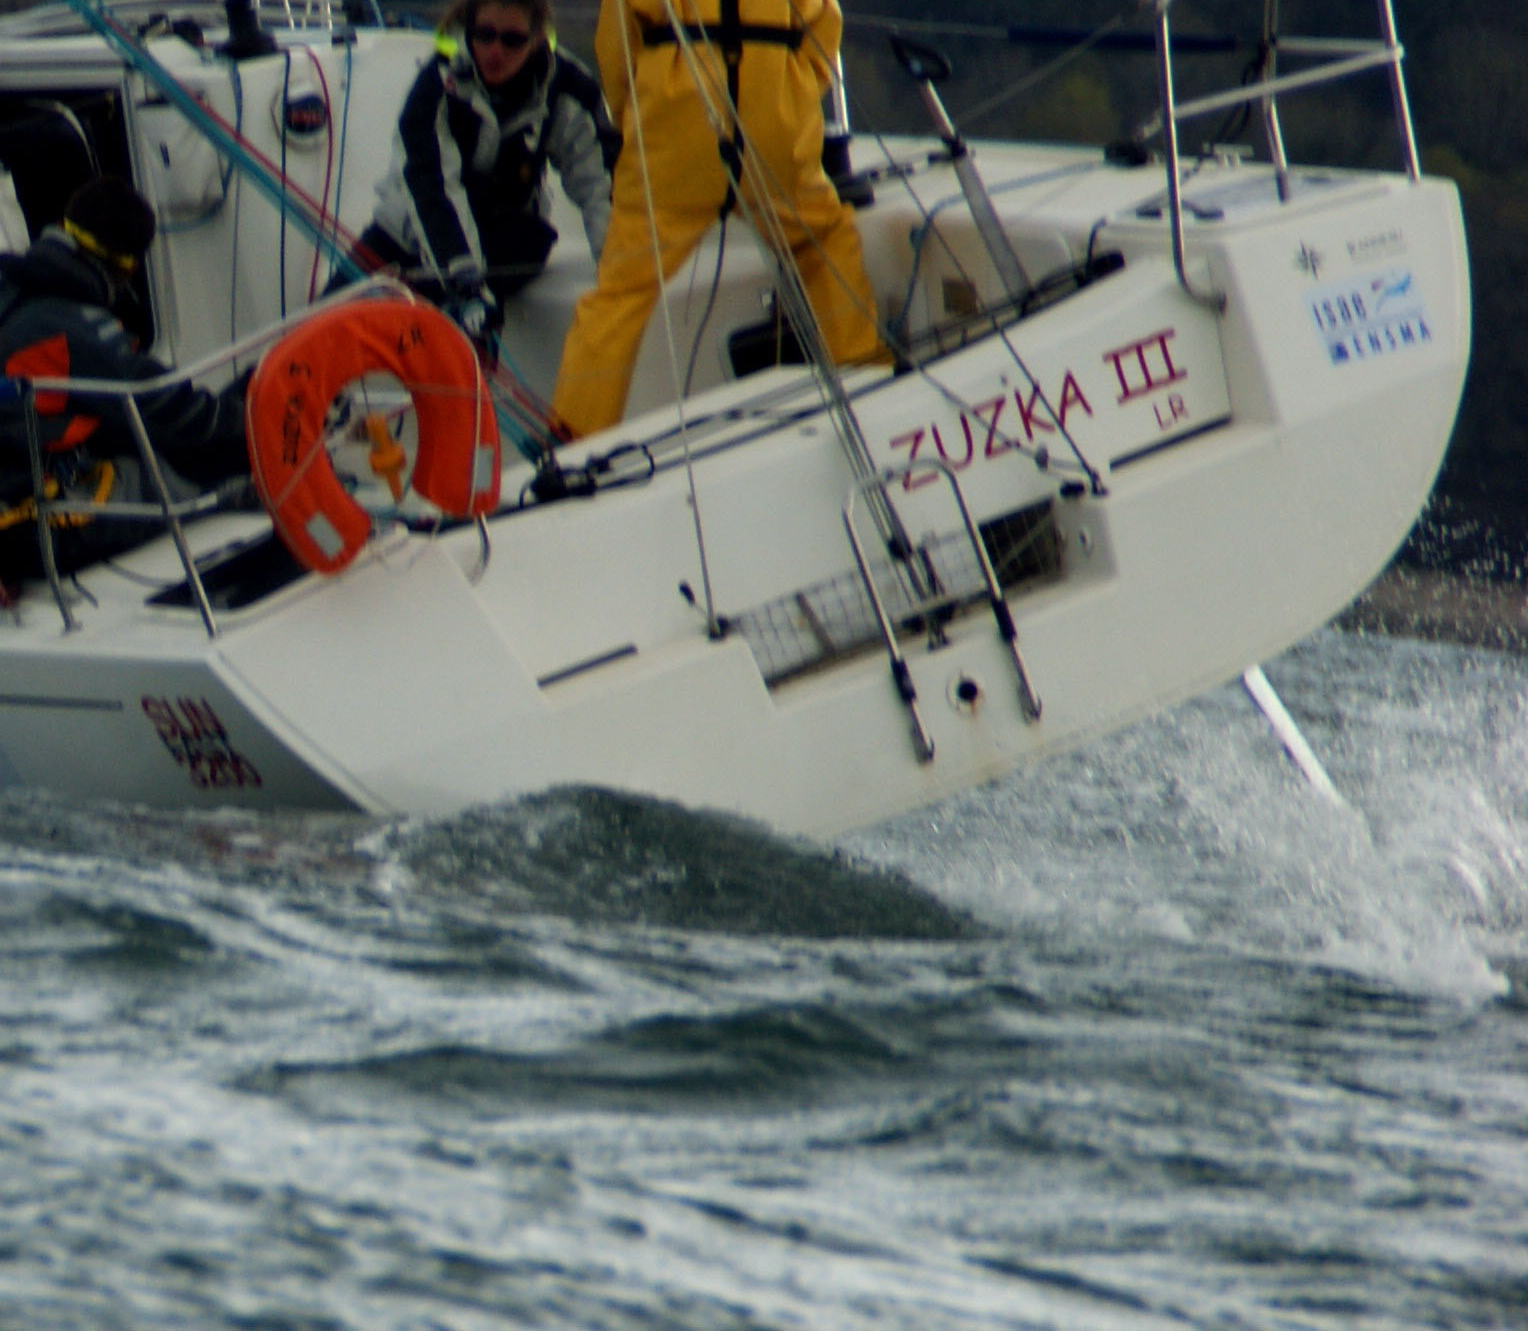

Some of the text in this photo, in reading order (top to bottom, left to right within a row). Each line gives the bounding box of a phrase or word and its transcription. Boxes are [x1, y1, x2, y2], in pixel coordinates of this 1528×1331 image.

[890, 328, 1188, 492] ZUZKA III
[1153, 393, 1189, 430] LR
